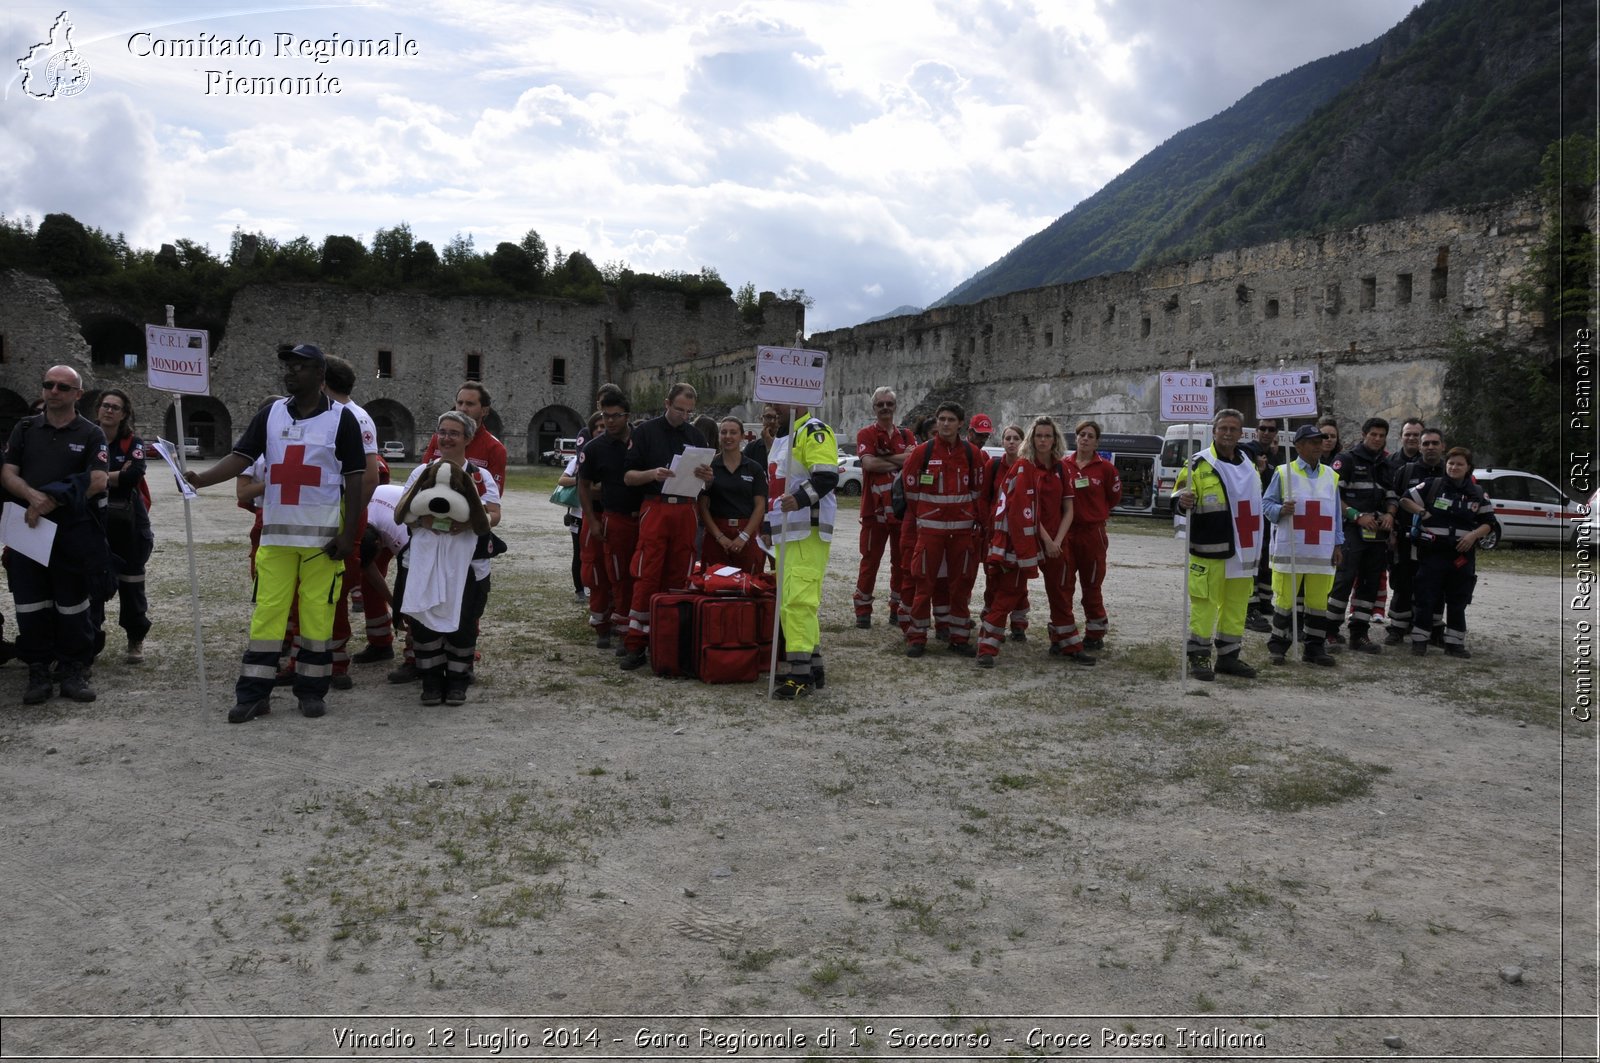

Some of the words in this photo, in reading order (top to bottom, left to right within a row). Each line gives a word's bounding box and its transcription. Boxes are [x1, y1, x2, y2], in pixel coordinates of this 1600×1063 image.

[760, 374, 821, 388] SAVIGLIANO
[1265, 388, 1306, 397] PRIGNANO
[1172, 394, 1208, 402] SETTIMO
[1171, 404, 1209, 412] TORINESE
